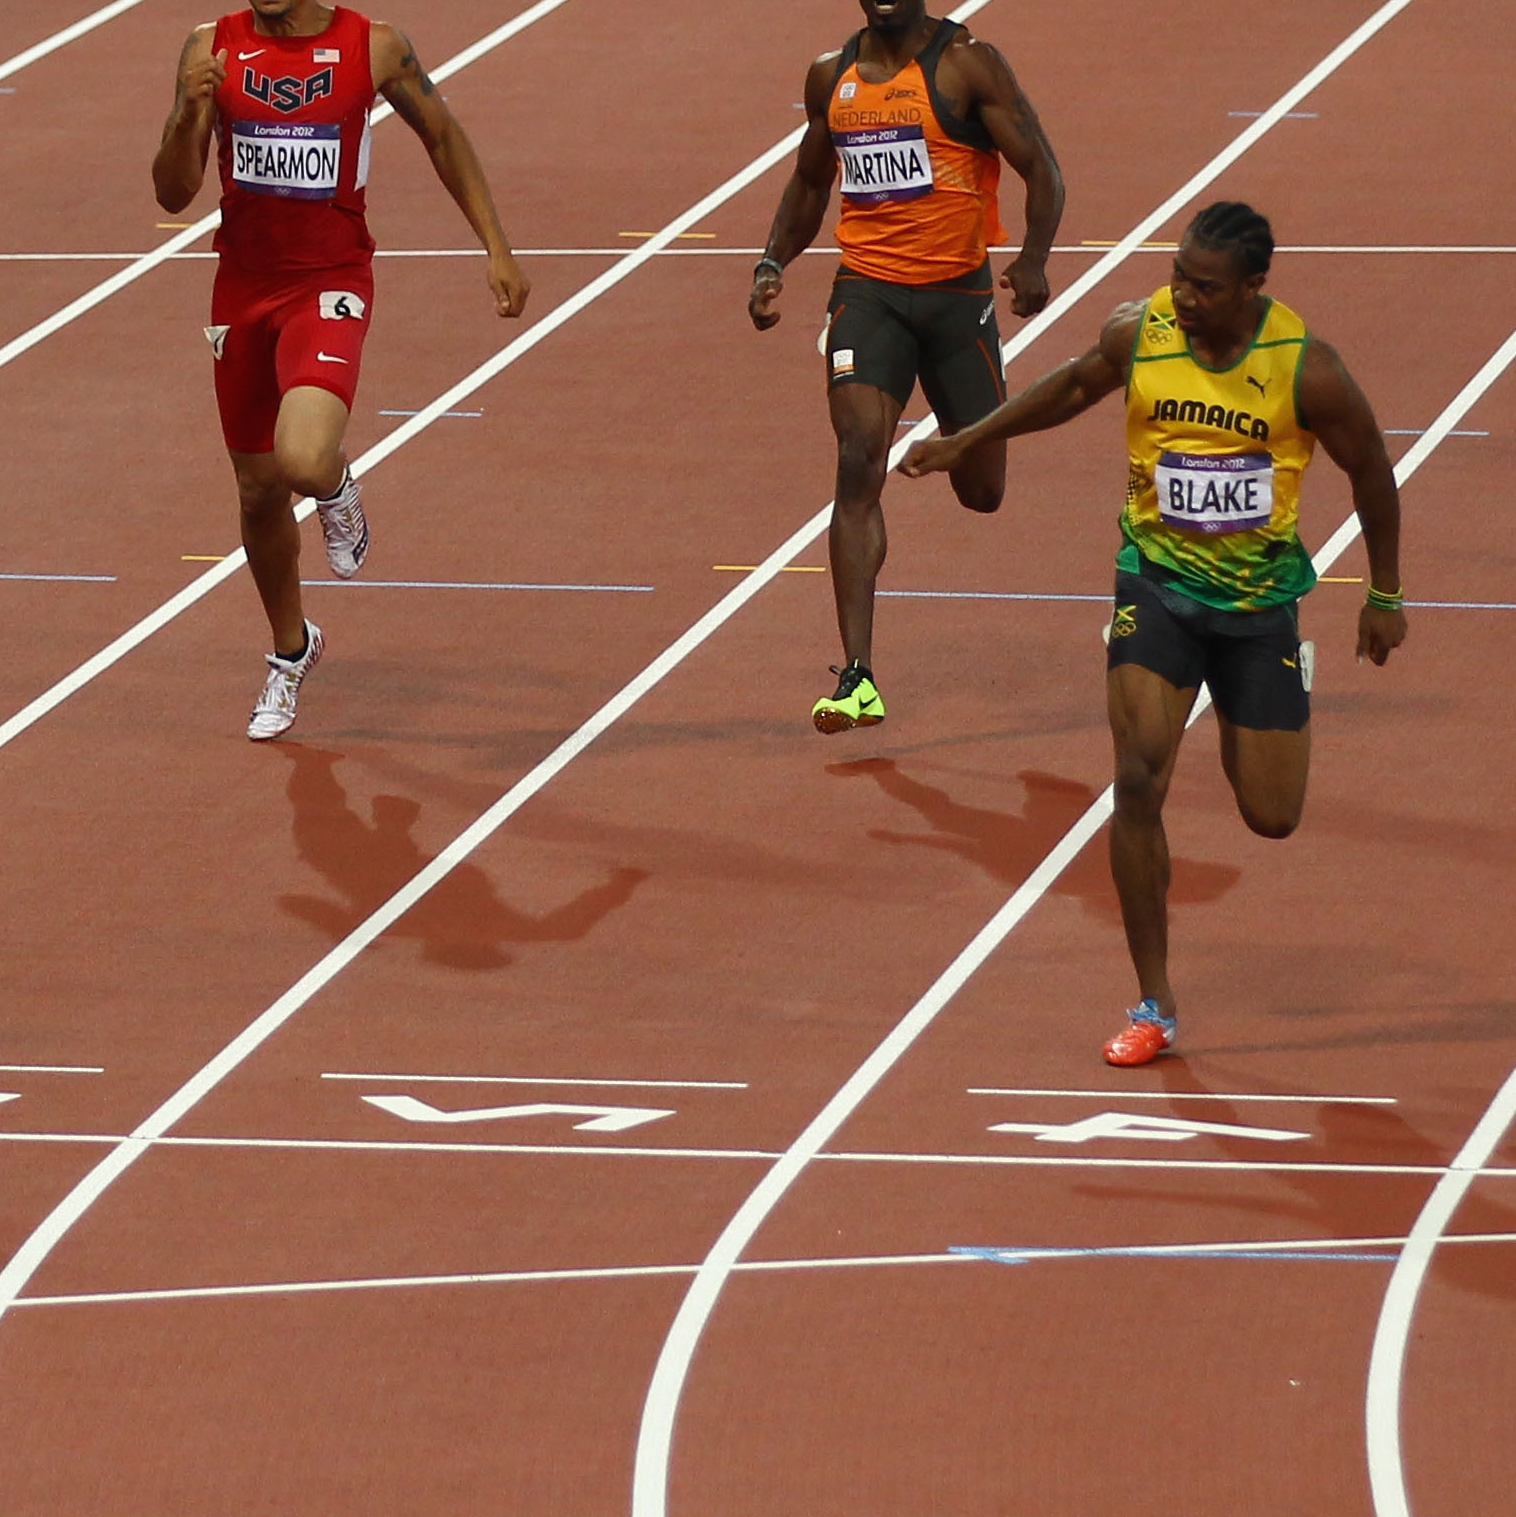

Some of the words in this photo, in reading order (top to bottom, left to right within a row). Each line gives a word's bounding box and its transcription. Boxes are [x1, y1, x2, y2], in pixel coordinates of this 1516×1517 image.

[243, 66, 333, 114] USA
[254, 125, 291, 136] London
[292, 126, 315, 136] 2012
[833, 107, 921, 126] NEDERLAND
[847, 132, 877, 144] London
[877, 130, 899, 141] 2012
[237, 141, 336, 181] SPEARMON
[842, 147, 925, 185] MARTINA
[334, 296, 351, 316] 6
[1147, 399, 1270, 443] JAMAICA
[1181, 457, 1220, 468] London
[1221, 458, 1246, 469] 2012
[1169, 477, 1258, 514] BLAKE
[360, 1094, 677, 1132] 5
[986, 1111, 1311, 1143] 4
